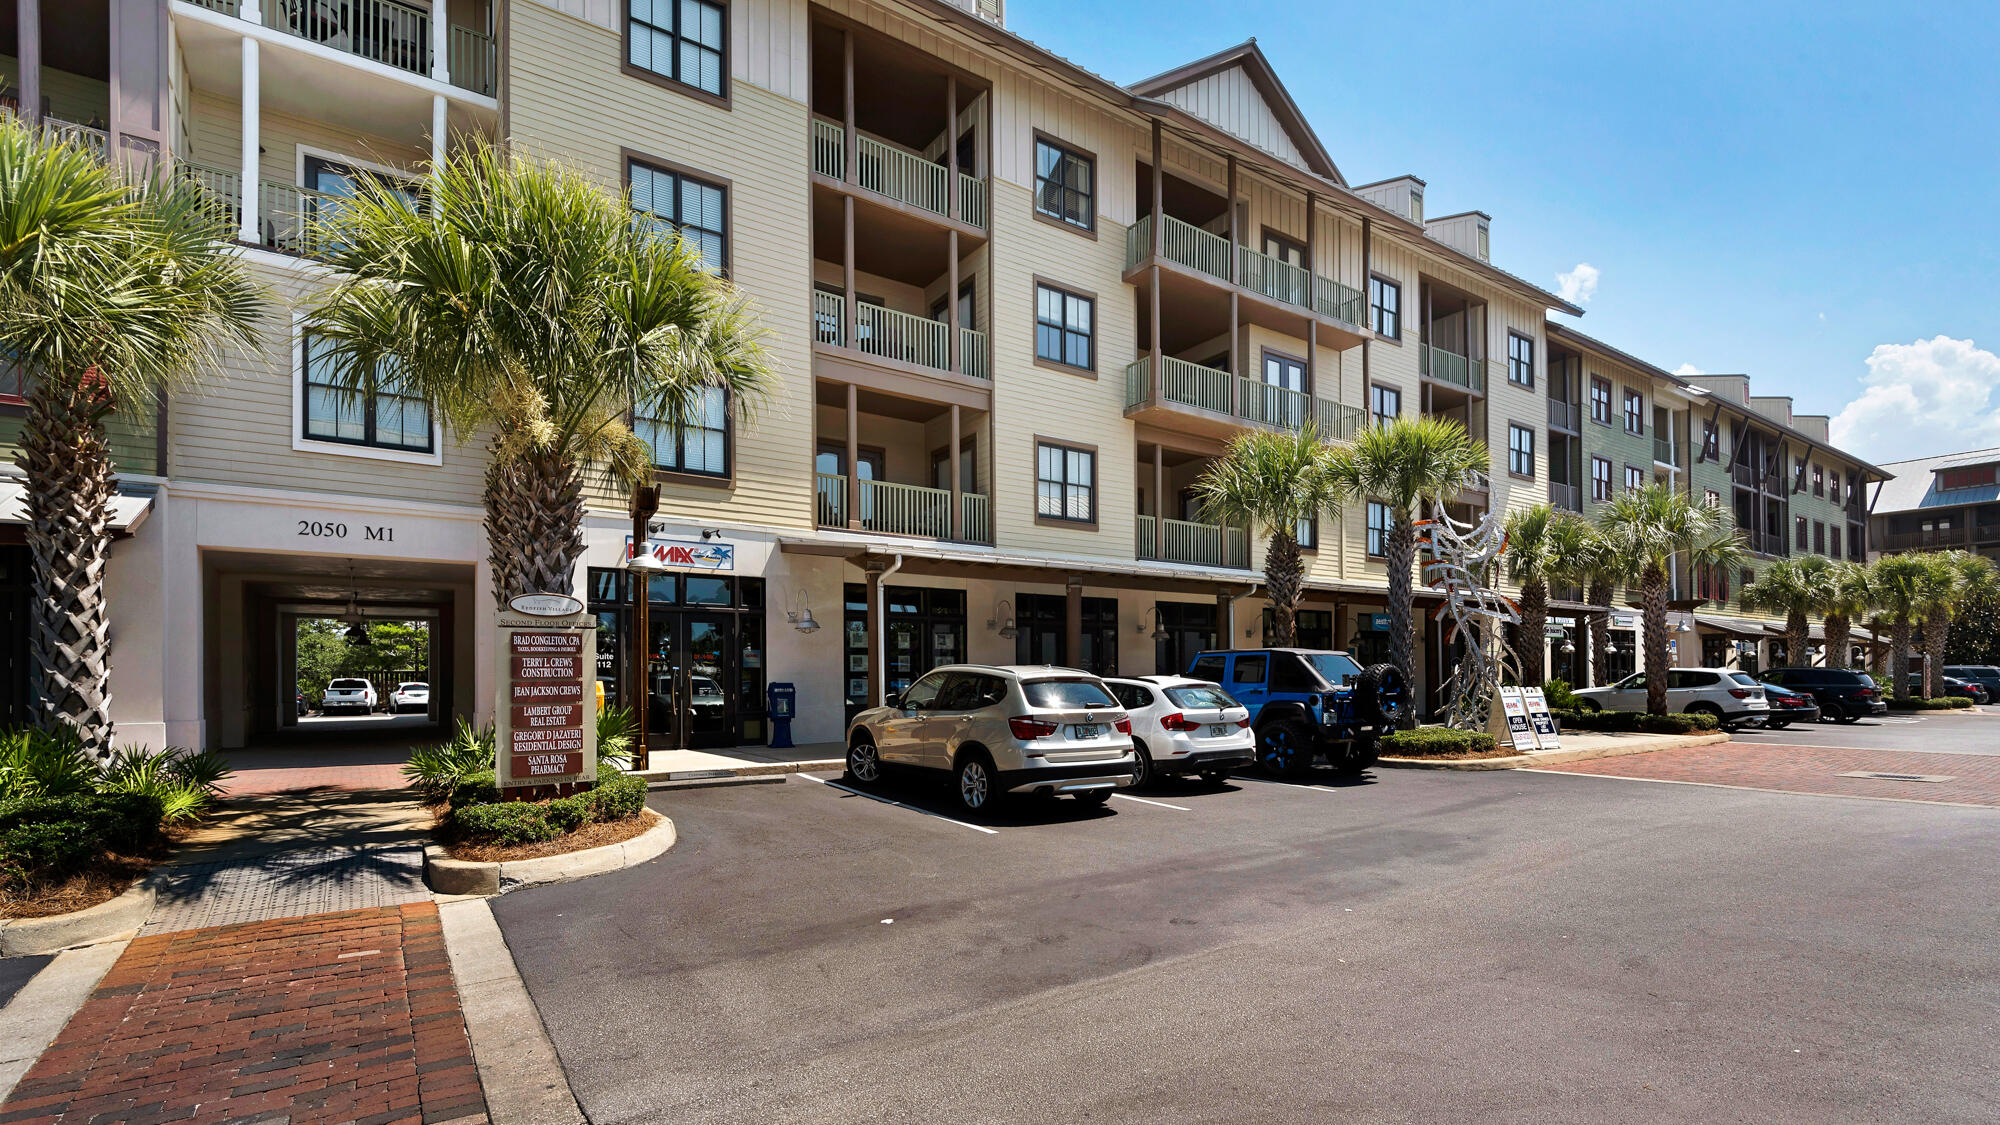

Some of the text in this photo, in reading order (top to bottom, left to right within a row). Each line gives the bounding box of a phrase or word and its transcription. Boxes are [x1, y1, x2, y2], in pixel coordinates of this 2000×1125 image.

[298, 520, 394, 542] 2050 M1
[500, 618, 533, 626] SECOND
[561, 619, 592, 627] OFFICES
[513, 635, 580, 646] BRAD CONGLETON, CPA
[595, 652, 614, 660] Suite
[522, 657, 573, 667] TERRY L. CREWS
[597, 660, 612, 668] 112
[521, 667, 574, 678] CONSTRUCTION
[514, 685, 581, 698] JEAN JACKSON CREWS
[523, 705, 573, 716] LAMBERT GROUP
[530, 716, 567, 727] REAL ESTATE
[1512, 716, 1523, 724] OPEN
[1511, 723, 1528, 731] HOUSE
[513, 729, 581, 741] GREGORY D JAZAYERI
[513, 739, 582, 752] RESIDENTIAL DESIGN
[527, 754, 568, 765] SANTA ROSA
[530, 764, 565, 775] PHARMACY
